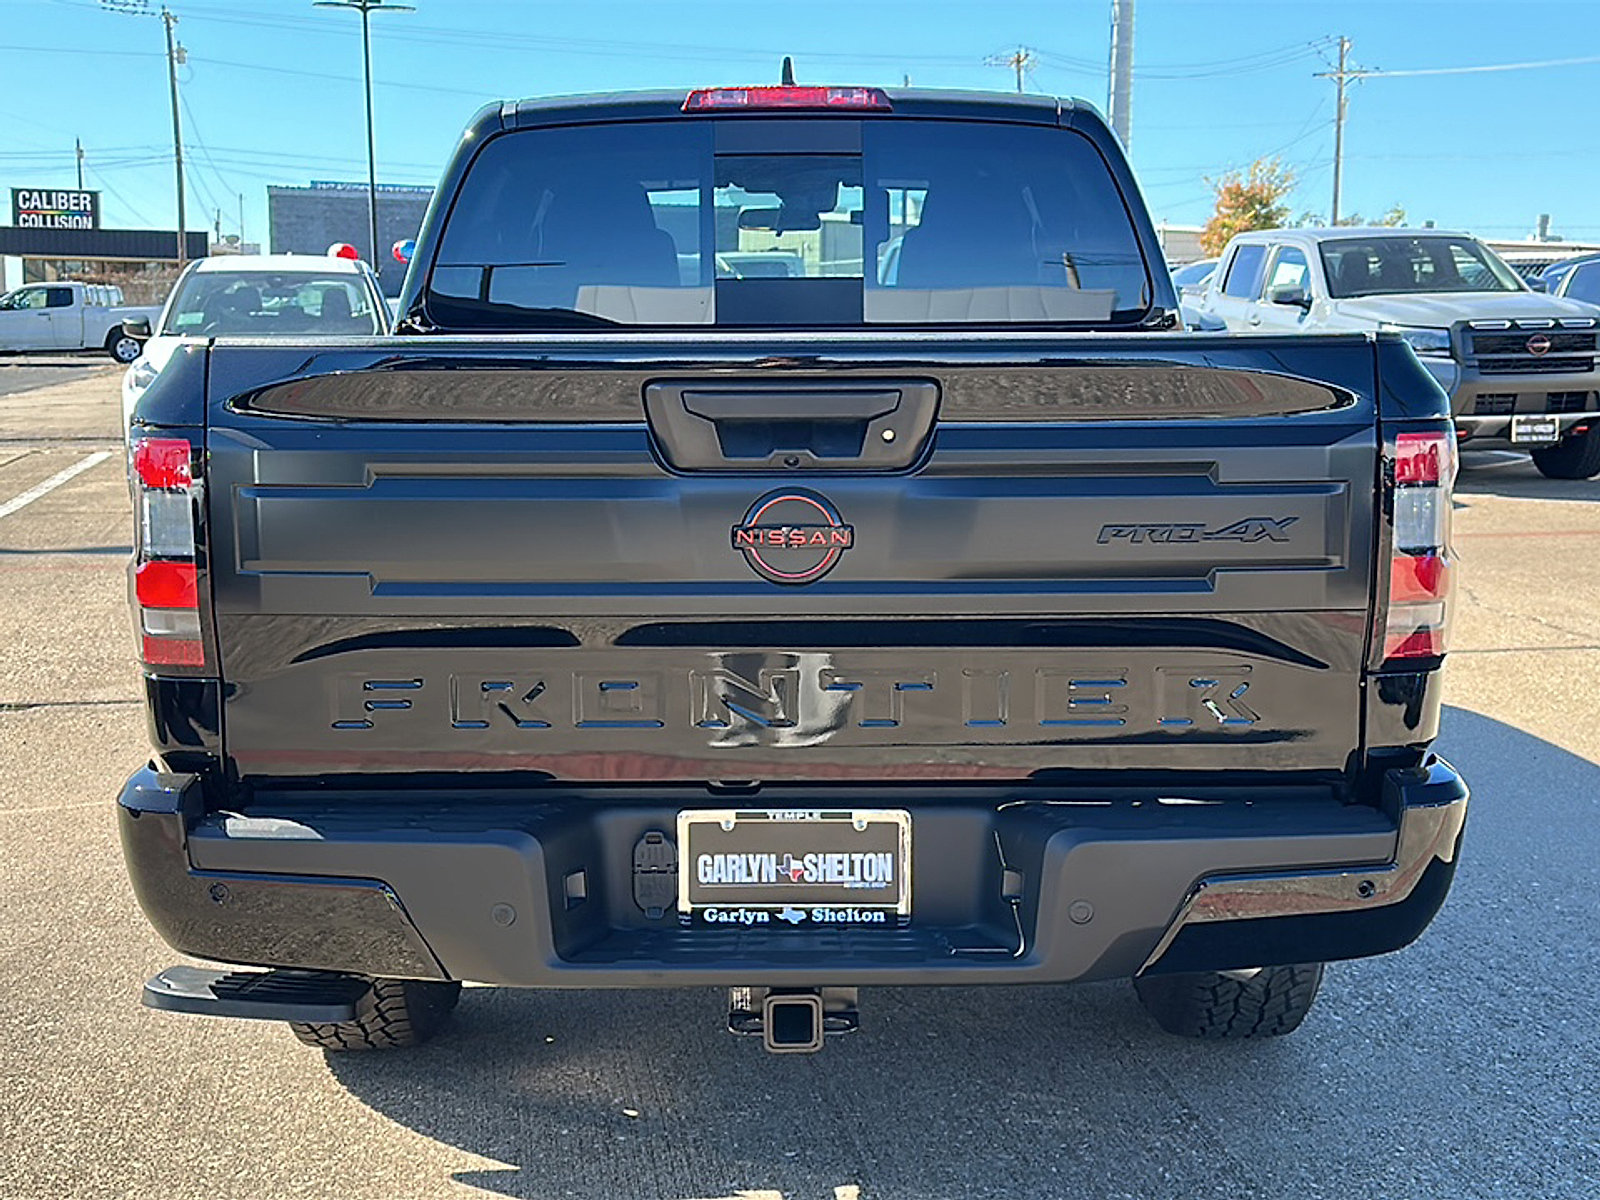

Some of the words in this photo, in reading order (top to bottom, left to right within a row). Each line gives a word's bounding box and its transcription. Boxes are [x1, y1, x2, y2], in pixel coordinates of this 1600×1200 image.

[18, 190, 92, 211] CALIBER
[18, 213, 93, 230] COLLISION
[736, 529, 850, 545] NISSAN
[1097, 516, 1299, 544] PRO-4X
[331, 666, 1261, 728] FRONTIER
[766, 811, 821, 820] TEMPLE
[698, 853, 777, 883] GARLYN
[803, 852, 893, 882] SHELTON
[703, 908, 770, 923] Garlyn
[811, 908, 886, 923] Shelton
